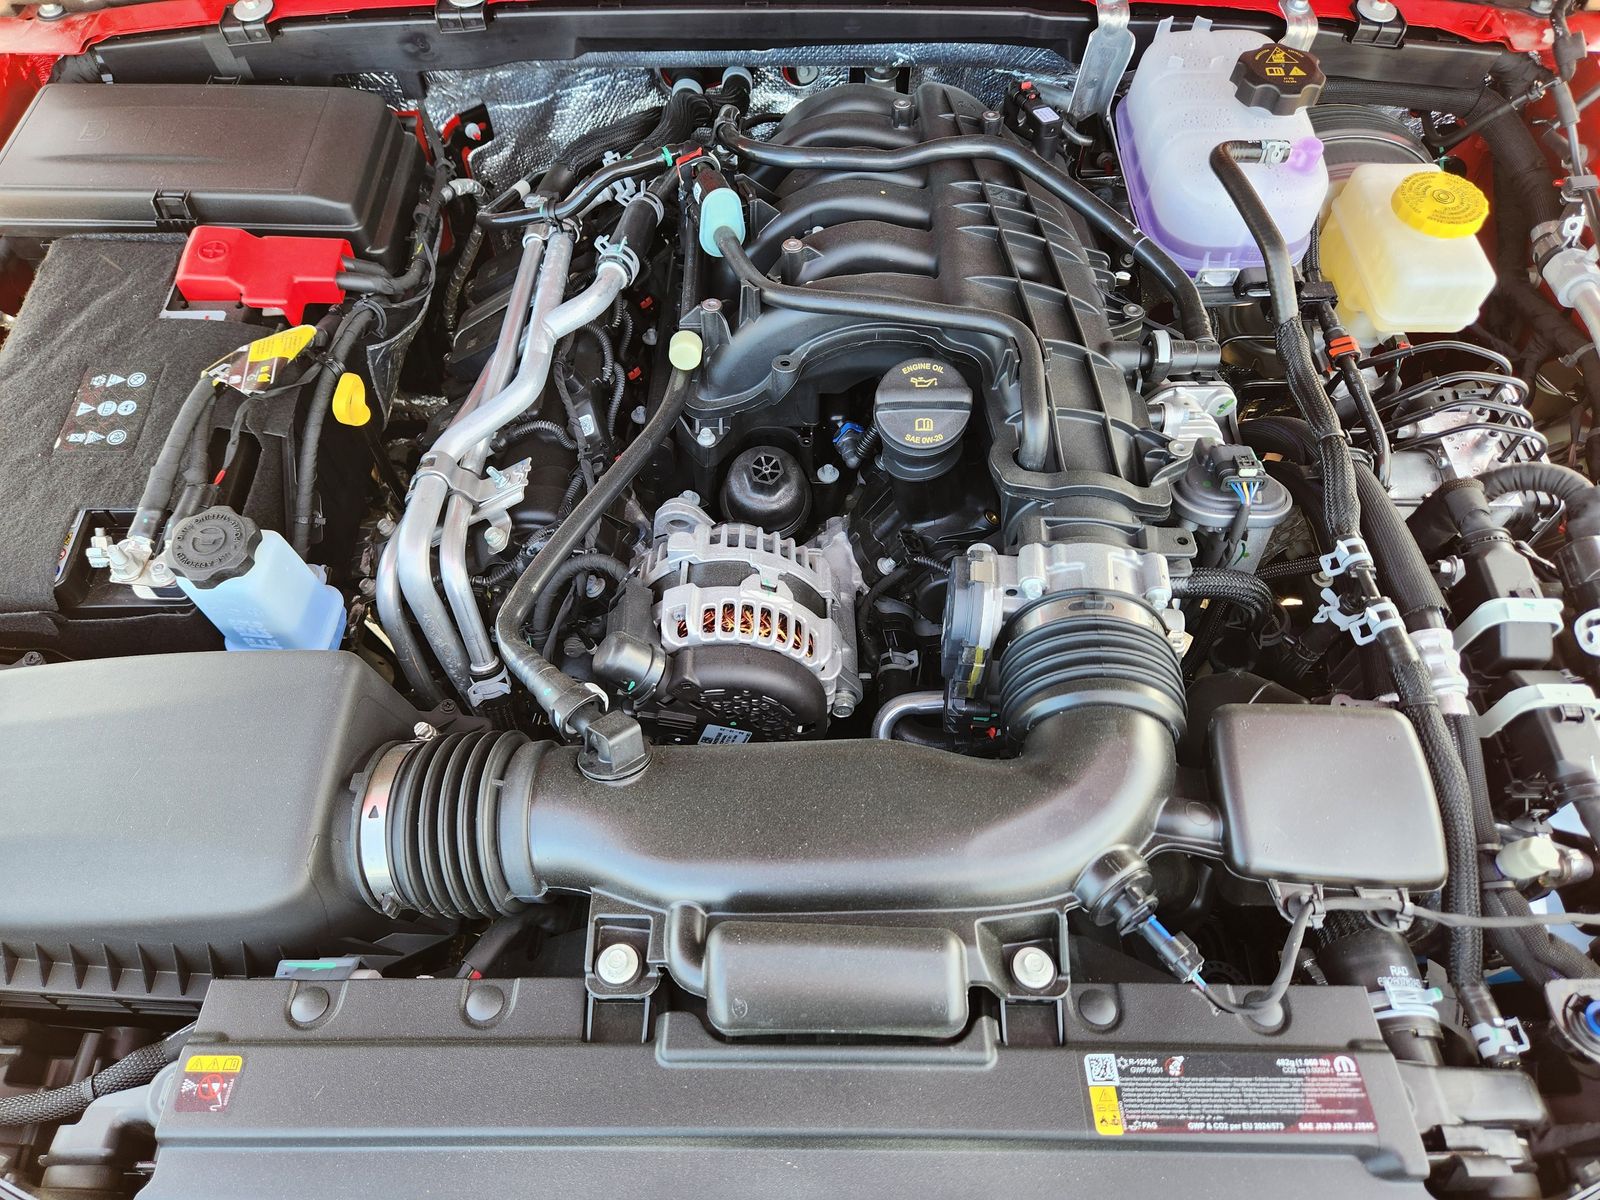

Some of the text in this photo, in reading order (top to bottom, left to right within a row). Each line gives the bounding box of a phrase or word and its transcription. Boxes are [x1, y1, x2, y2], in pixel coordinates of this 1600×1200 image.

[902, 363, 944, 374] ENGINE OIL
[904, 433, 944, 443] SAE 0W-20
[1389, 965, 1409, 976] RAD
[1128, 1058, 1158, 1067] R-1234yf
[1130, 1066, 1146, 1074] GWP
[1142, 1121, 1158, 1130] PAG
[1187, 1122, 1206, 1130] GWP
[1207, 1122, 1212, 1130] &
[1213, 1122, 1229, 1130] CO2
[1230, 1123, 1241, 1132] per
[1242, 1122, 1252, 1130] EU
[1298, 1122, 1314, 1130] SAE
